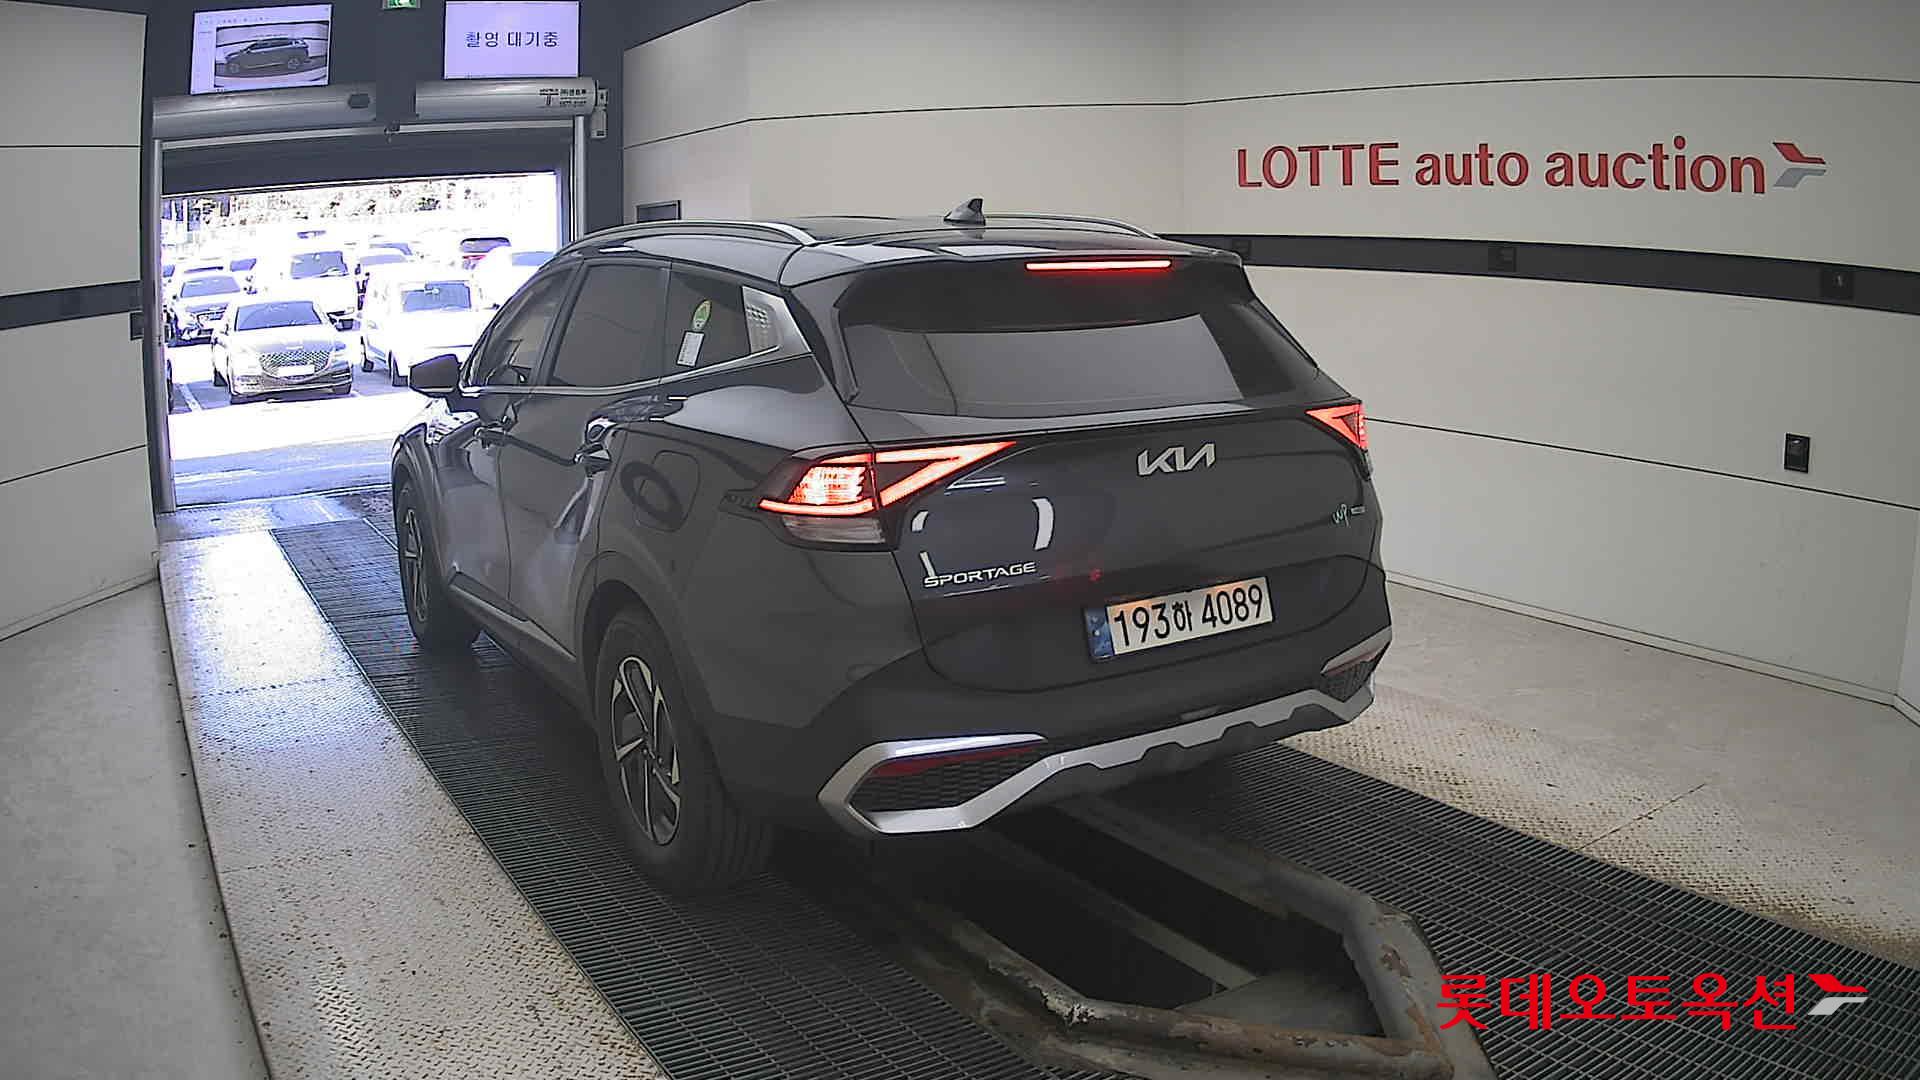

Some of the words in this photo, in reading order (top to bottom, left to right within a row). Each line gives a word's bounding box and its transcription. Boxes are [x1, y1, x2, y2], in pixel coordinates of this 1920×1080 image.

[465, 31, 499, 48] 촬영
[507, 31, 558, 48] 대기중
[1236, 141, 1400, 189] LOTTE
[1414, 142, 1529, 188] auto
[1544, 135, 1767, 195] auction
[1136, 441, 1216, 477] KIA
[923, 560, 1037, 589] SPORTAGE
[1113, 599, 1194, 648] 193하
[1201, 583, 1264, 629] 4089
